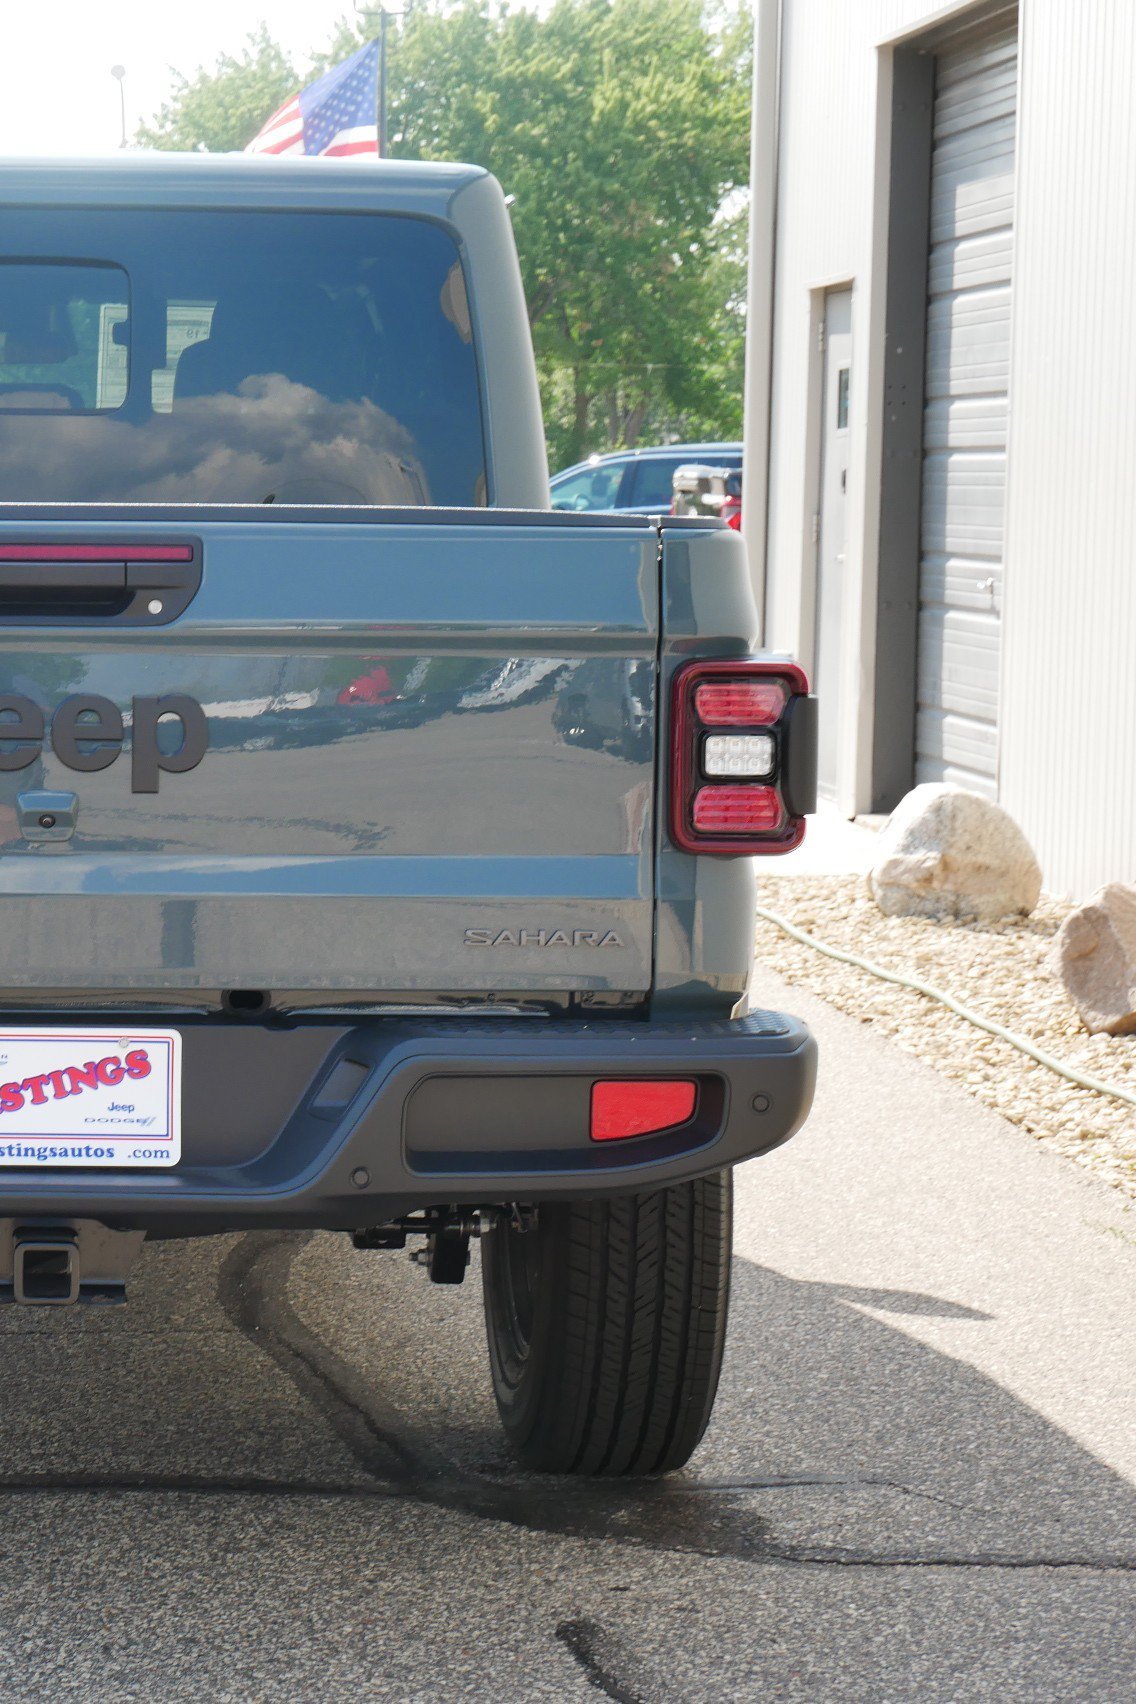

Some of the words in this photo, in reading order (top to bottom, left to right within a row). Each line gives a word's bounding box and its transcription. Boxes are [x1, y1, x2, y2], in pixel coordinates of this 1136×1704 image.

[463, 928, 625, 947] SAHARA
[107, 1102, 135, 1113] Jeep
[127, 1147, 170, 1159] .com
